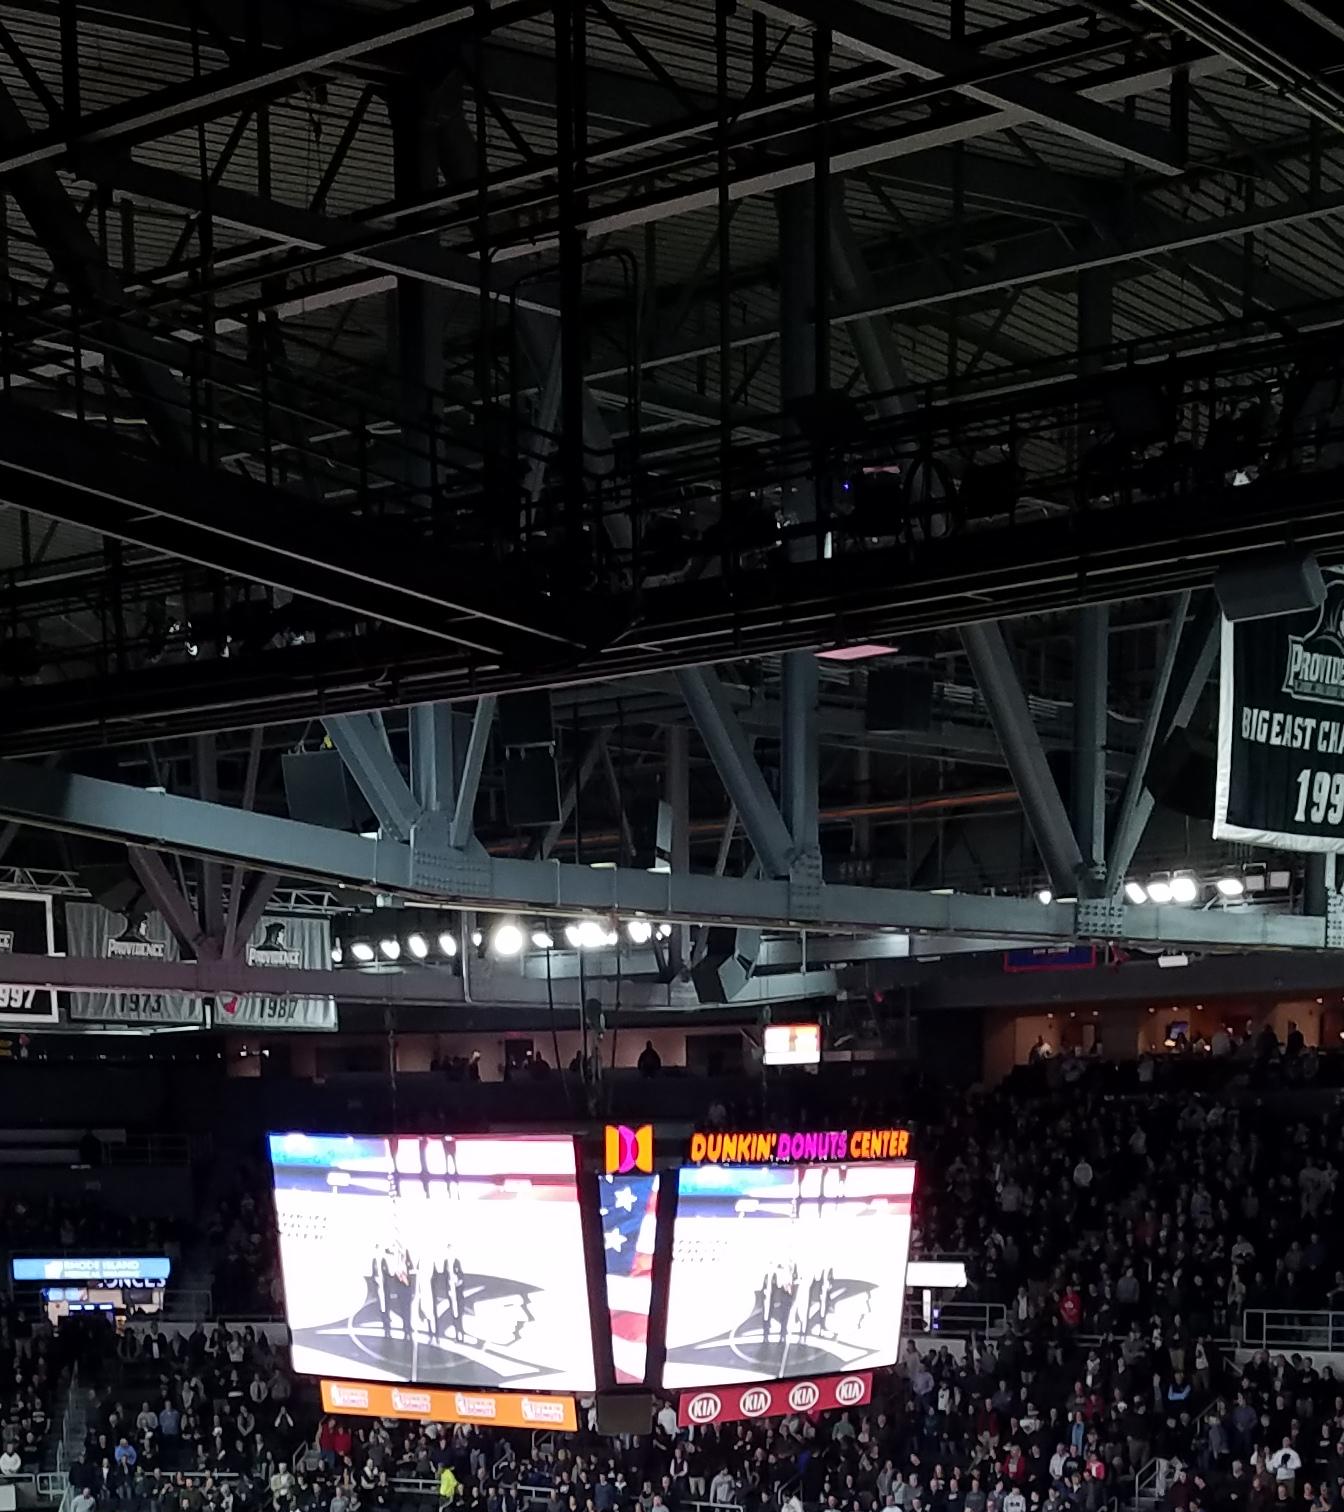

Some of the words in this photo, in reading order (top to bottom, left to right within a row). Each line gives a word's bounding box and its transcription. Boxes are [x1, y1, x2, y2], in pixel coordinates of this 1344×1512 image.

[1242, 707, 1269, 743] BIG
[1270, 712, 1316, 750] EAST
[108, 939, 165, 957] PROVIDENCE
[259, 999, 299, 1019] 1987
[690, 1131, 777, 1163] DUNKIN'
[777, 1131, 847, 1161] DONUTS
[850, 1129, 910, 1159] CENTER
[794, 1388, 814, 1405] KIA
[841, 1382, 861, 1400] KIA
[694, 1399, 719, 1417] KIA
[745, 1394, 766, 1412] KIA
